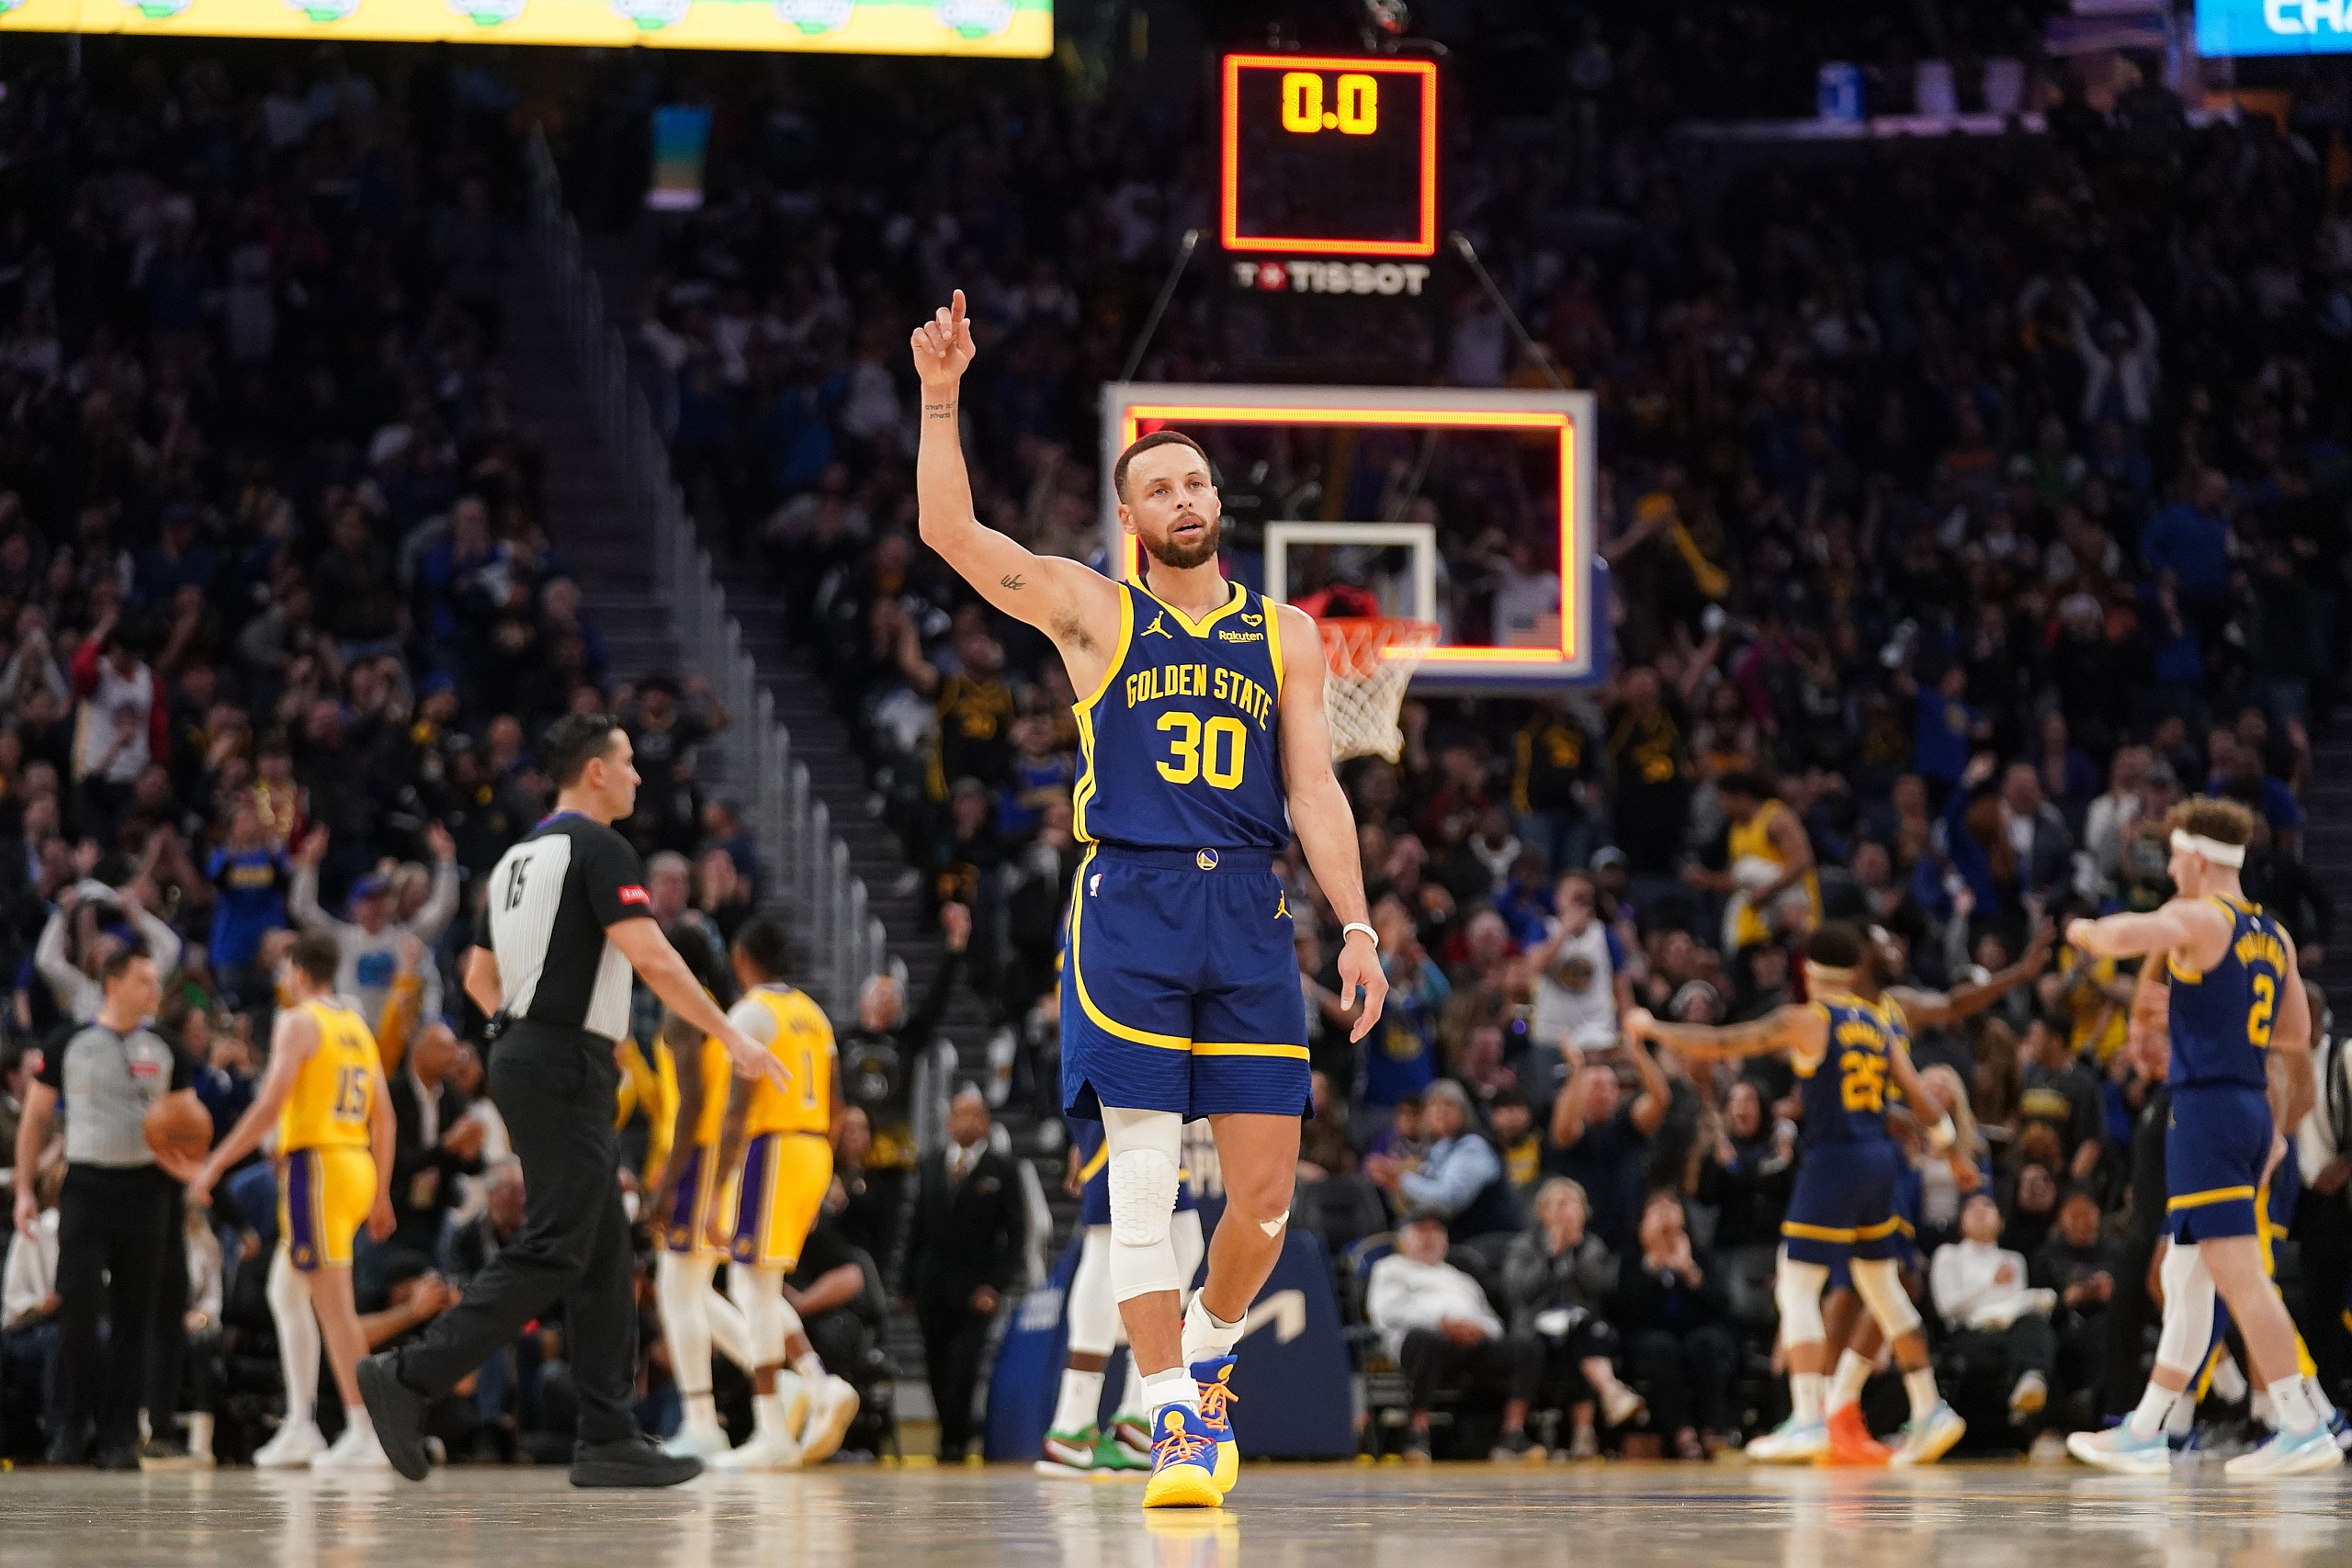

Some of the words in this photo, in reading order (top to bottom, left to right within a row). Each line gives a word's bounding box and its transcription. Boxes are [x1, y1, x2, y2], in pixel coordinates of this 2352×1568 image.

[2263, 0, 2352, 35] CH
[1282, 72, 1377, 135] 0.0
[1287, 261, 1430, 296] TISSOT
[1218, 630, 1264, 642] Rakuten
[1126, 663, 1207, 709] GOLDEN
[1214, 667, 1273, 731] STATE
[1156, 711, 1248, 790] 30
[504, 856, 533, 911] 15
[2247, 973, 2275, 1048] 2
[334, 1065, 368, 1120] 15
